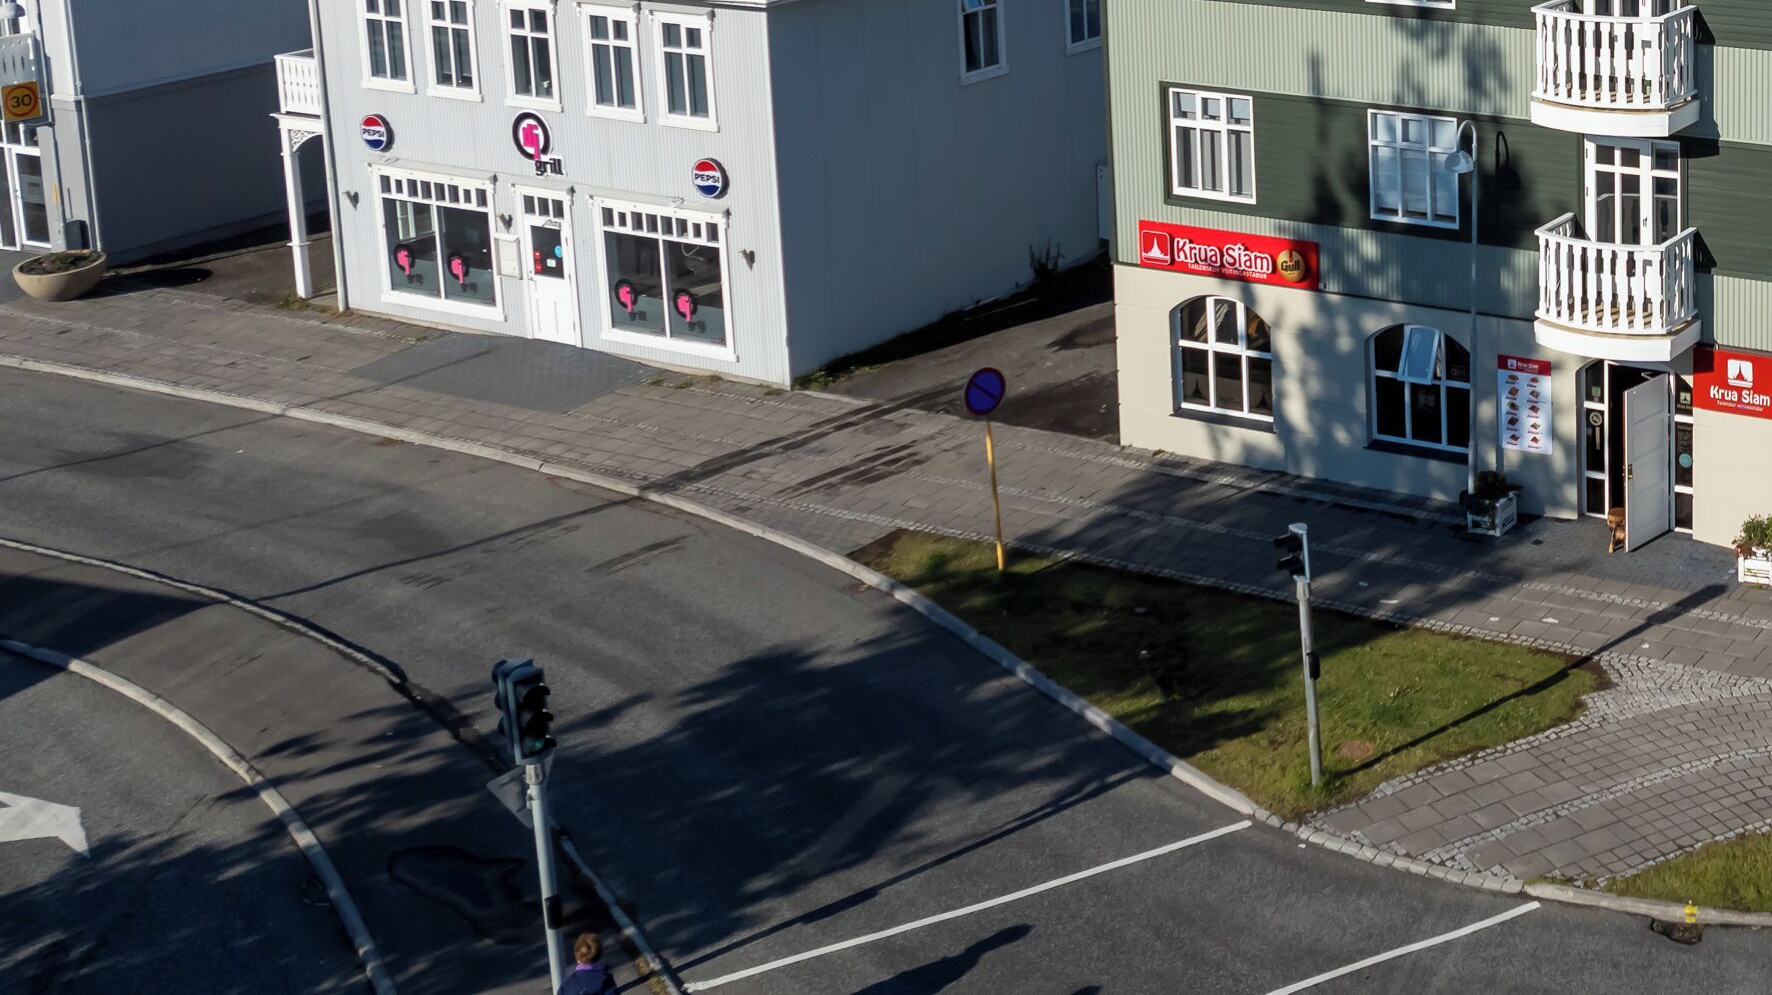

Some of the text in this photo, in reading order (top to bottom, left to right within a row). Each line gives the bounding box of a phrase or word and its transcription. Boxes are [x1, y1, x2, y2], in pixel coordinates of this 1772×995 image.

[10, 94, 32, 109] 30
[362, 127, 385, 138] PEPSI
[535, 157, 565, 177] grill
[694, 172, 721, 184] PEPSI
[1173, 237, 1273, 274] Krua Siam
[1280, 260, 1300, 273] Gull
[1709, 384, 1738, 402] Krua
[1741, 389, 1771, 407] Siam
